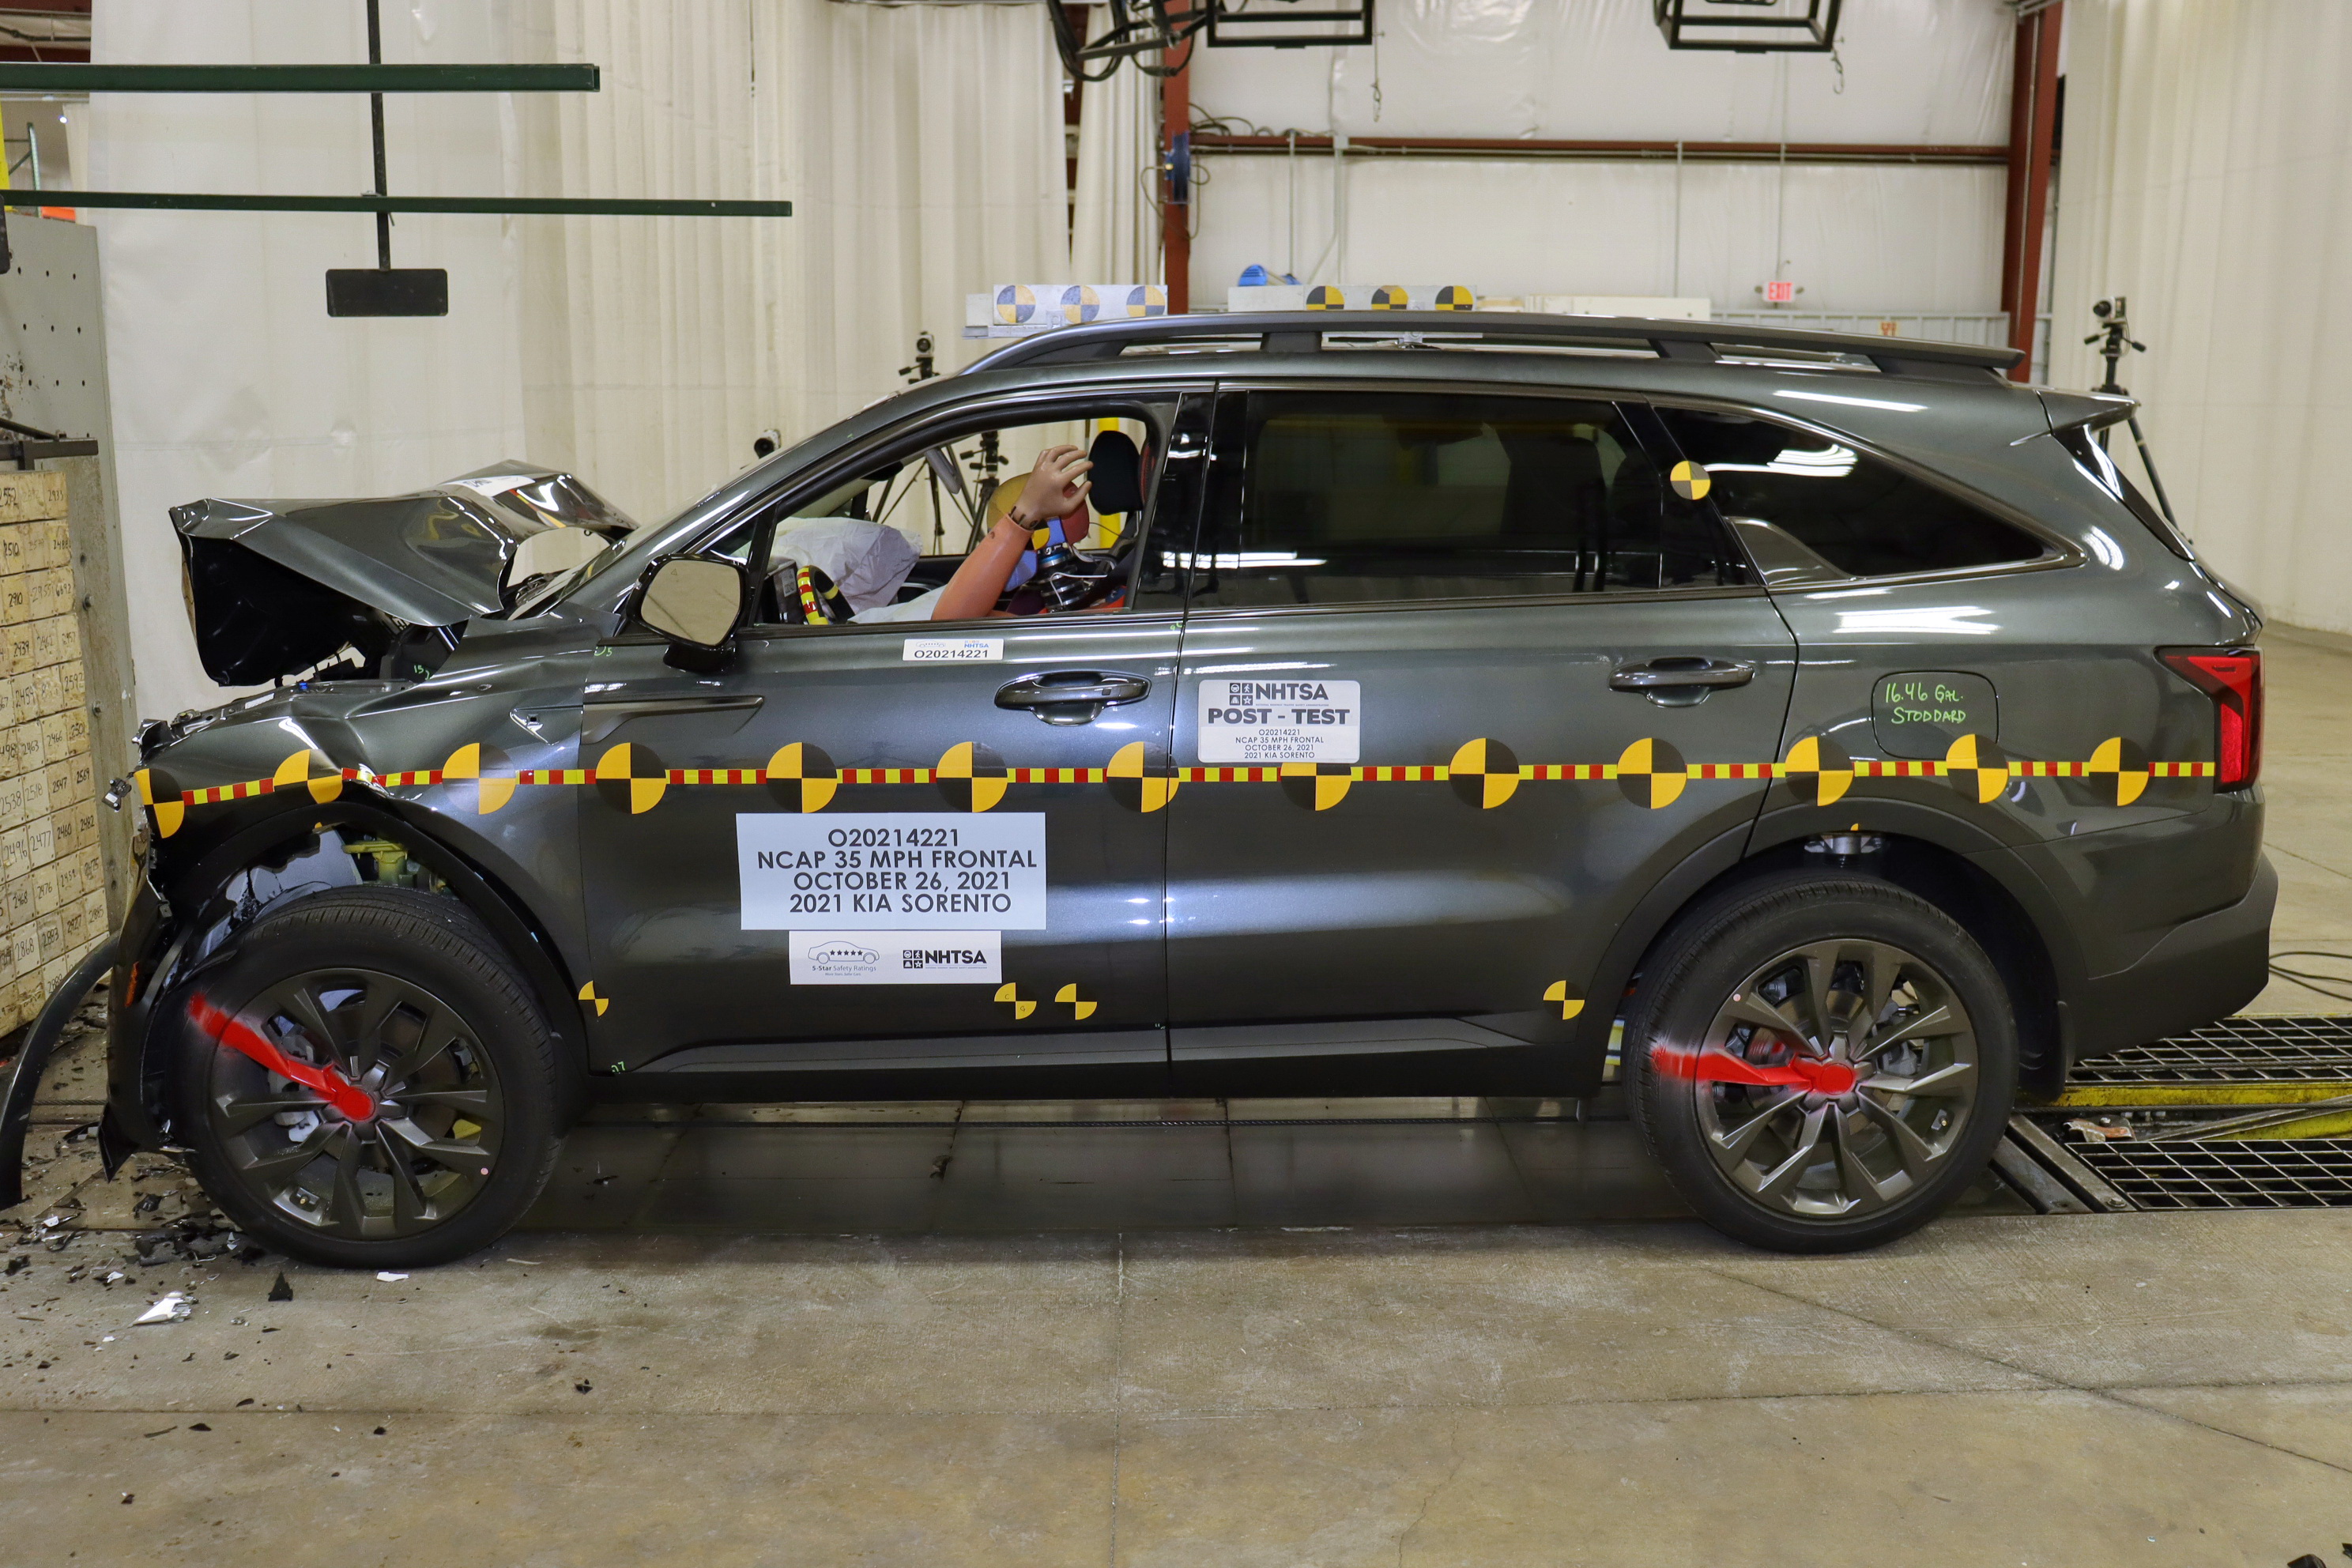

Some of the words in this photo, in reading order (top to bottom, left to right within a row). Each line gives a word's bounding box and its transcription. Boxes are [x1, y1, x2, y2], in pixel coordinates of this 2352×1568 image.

[1768, 281, 1792, 300] EXIT
[1255, 683, 1329, 700] NHTSA
[1208, 708, 1272, 725] POST
[1291, 708, 1351, 725] TEST
[1890, 707, 1966, 725] STODDARD
[29, 830, 51, 852] 2477
[758, 850, 826, 869] NCAP
[835, 850, 861, 869] 35
[870, 850, 922, 869] MPH
[932, 850, 1037, 868] FRONTAL
[794, 872, 906, 890] OCTOBER
[914, 872, 948, 893] 26,
[957, 871, 1009, 890] 2021
[790, 894, 842, 913] 2021
[854, 894, 892, 912] KIA
[902, 893, 1012, 913] SORENTO
[15, 937, 35, 962] 2868
[925, 950, 987, 964] NHTSA
